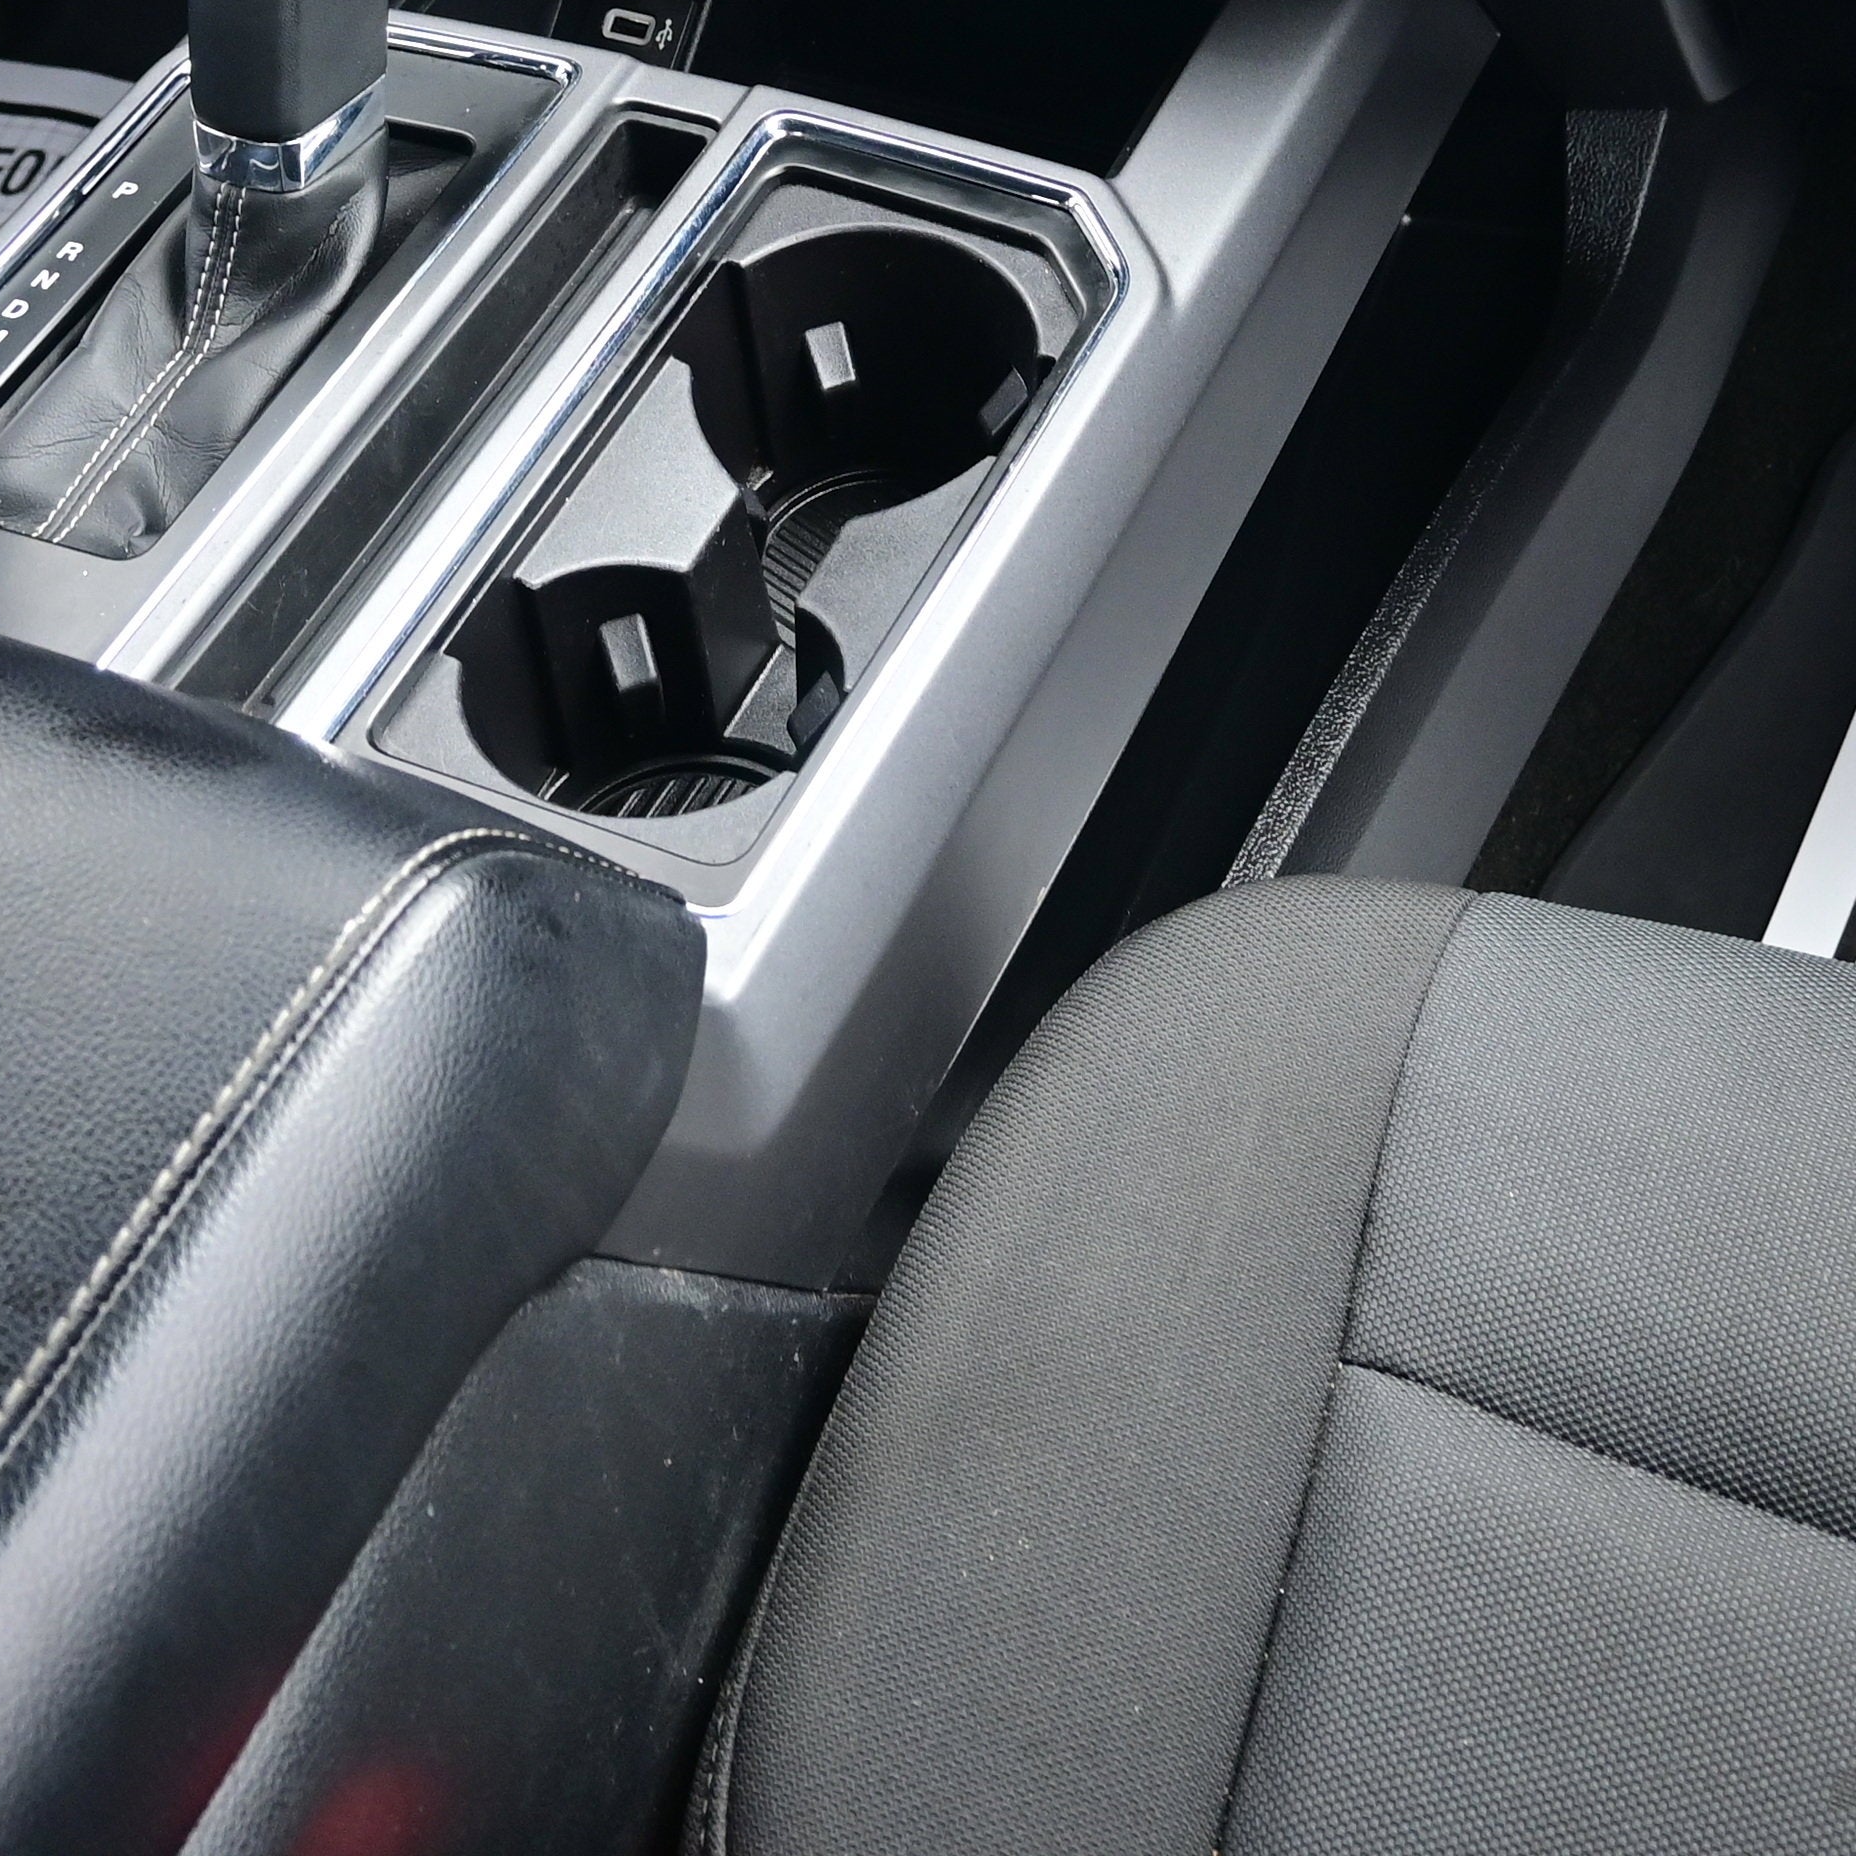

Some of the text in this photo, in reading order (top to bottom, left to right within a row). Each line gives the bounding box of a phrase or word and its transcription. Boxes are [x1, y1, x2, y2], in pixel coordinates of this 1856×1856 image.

[111, 181, 138, 199] P
[55, 241, 83, 261] R
[30, 270, 60, 291] N
[1, 299, 29, 319] D
